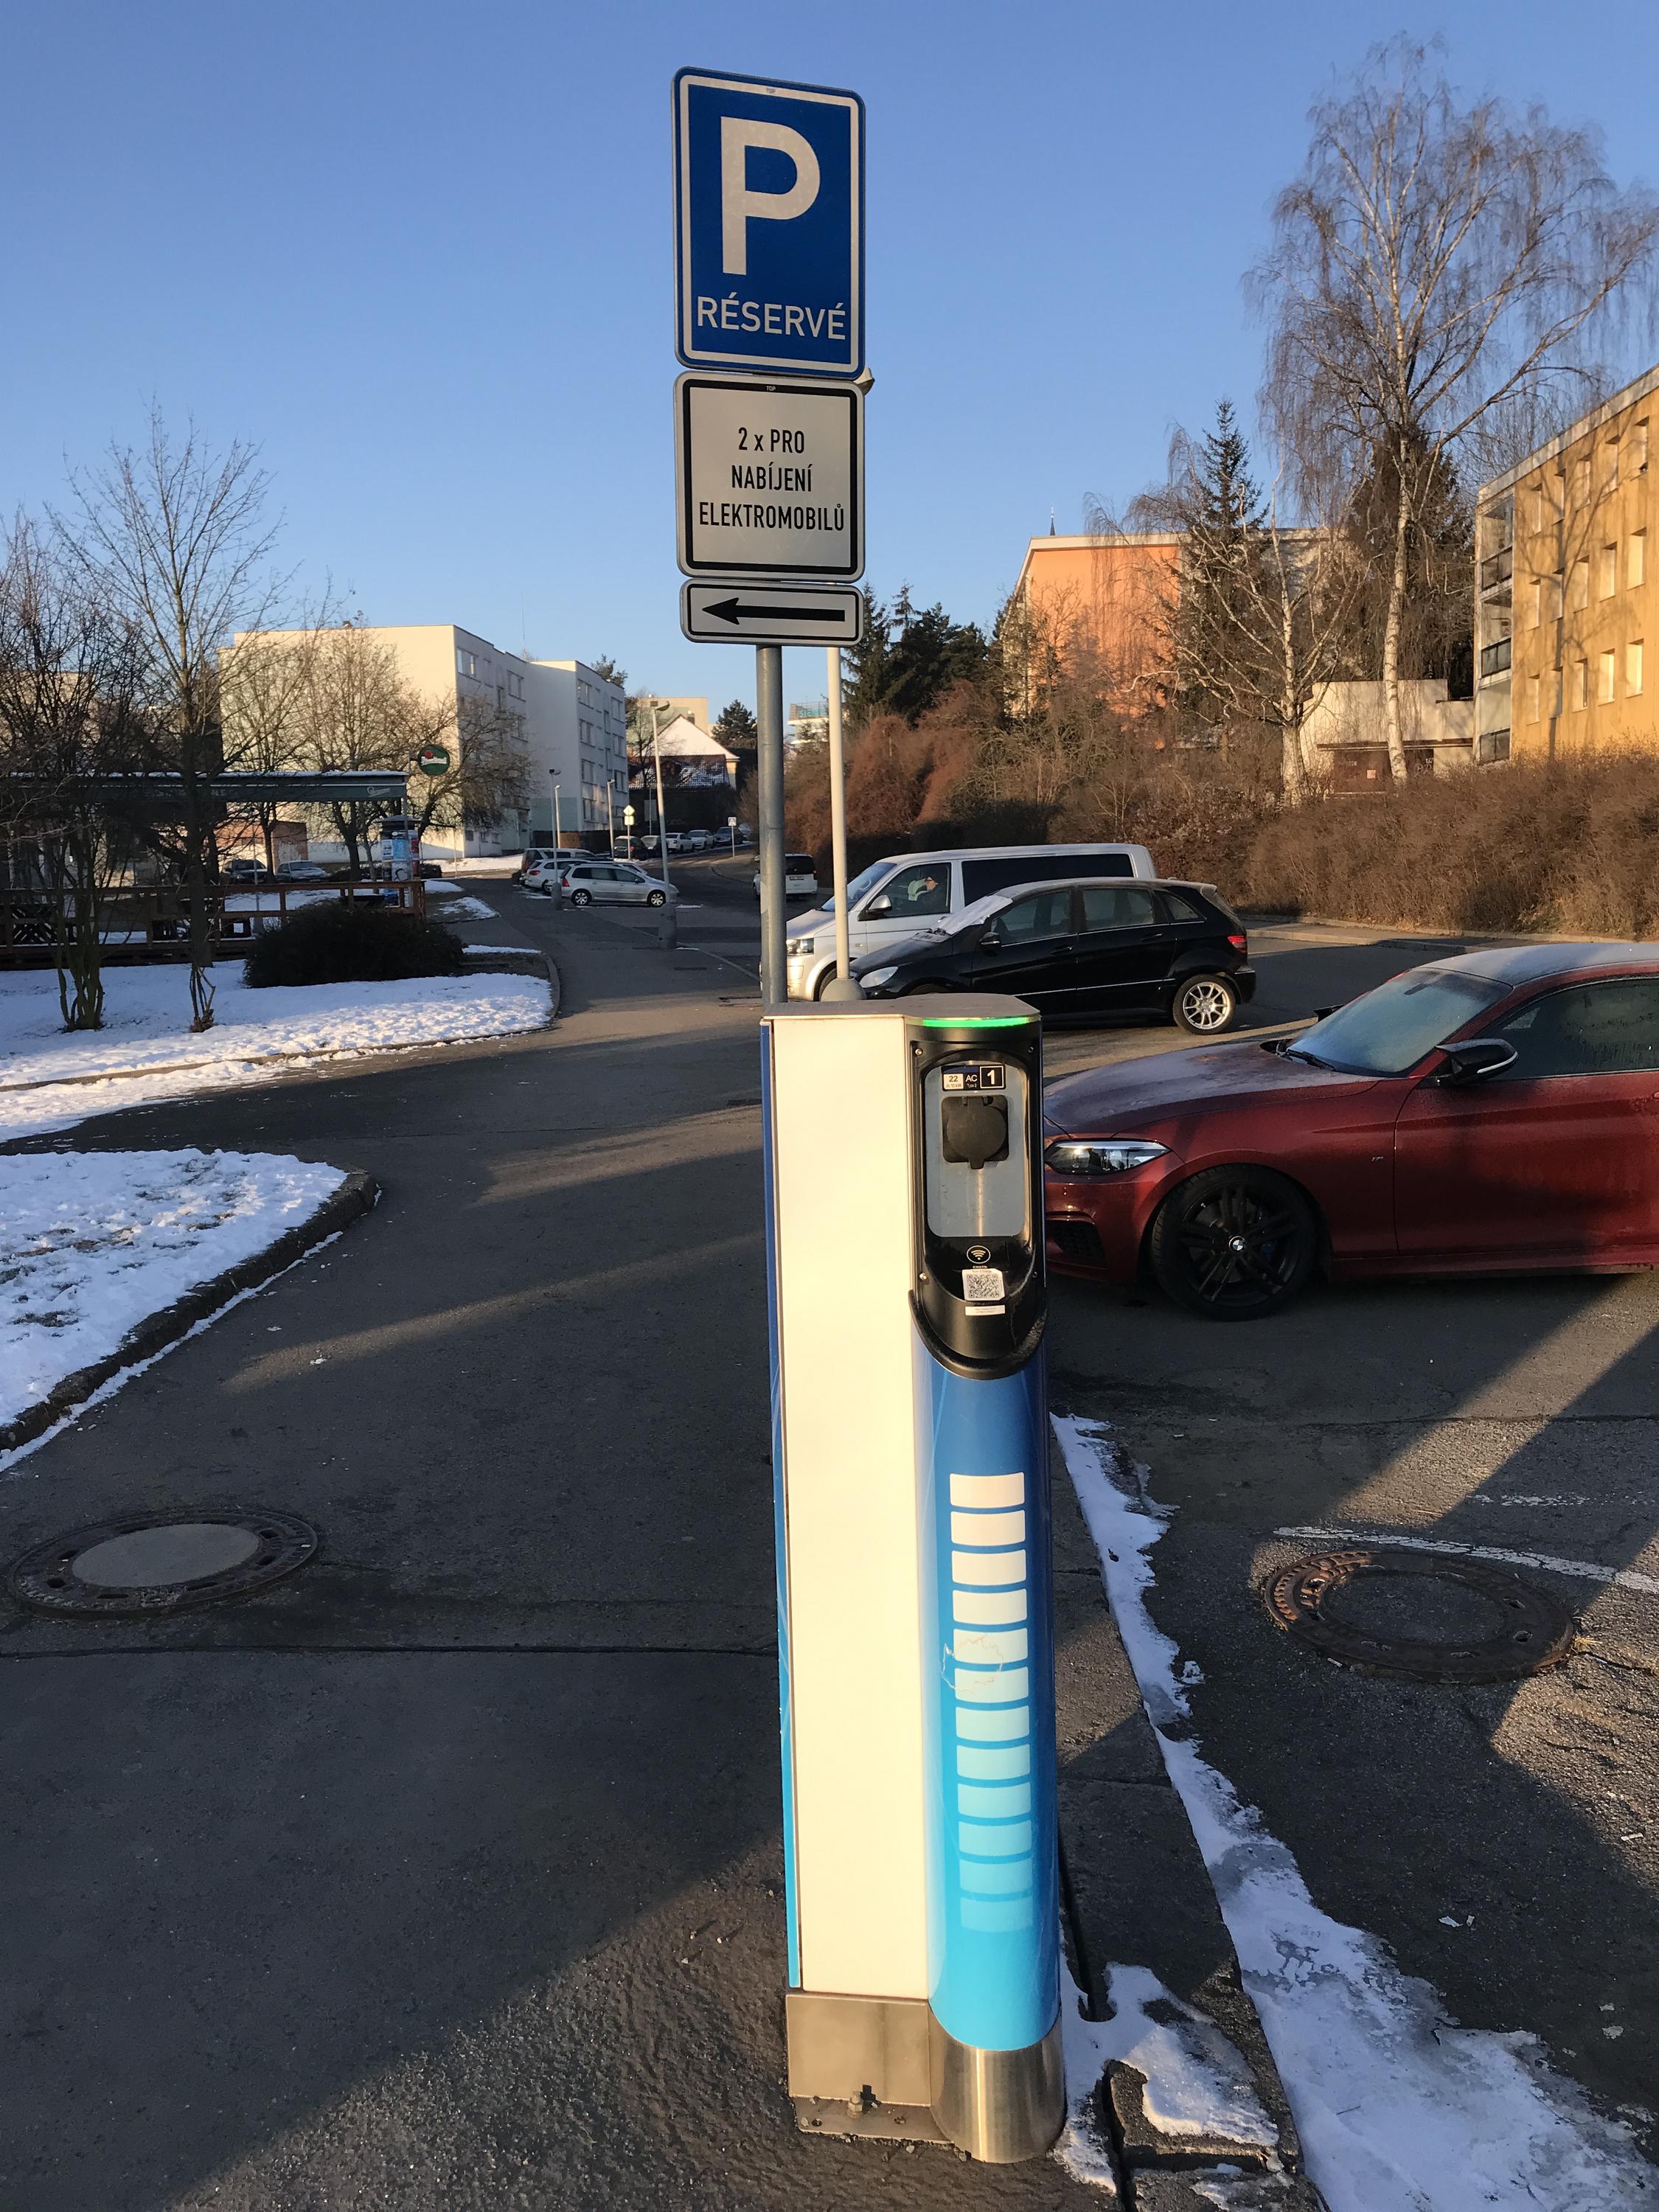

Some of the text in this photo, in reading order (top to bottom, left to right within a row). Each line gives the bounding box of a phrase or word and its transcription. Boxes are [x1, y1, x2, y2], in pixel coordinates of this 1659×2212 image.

[720, 116, 820, 275] P
[698, 292, 846, 340] RÉSERVÉ
[738, 427, 805, 454] 2 x PRO
[731, 462, 813, 493] NABÍJENÍ
[699, 501, 845, 532] ELEKTROMOBILŮ
[965, 1074, 978, 1082] AC
[987, 1070, 995, 1085] 1
